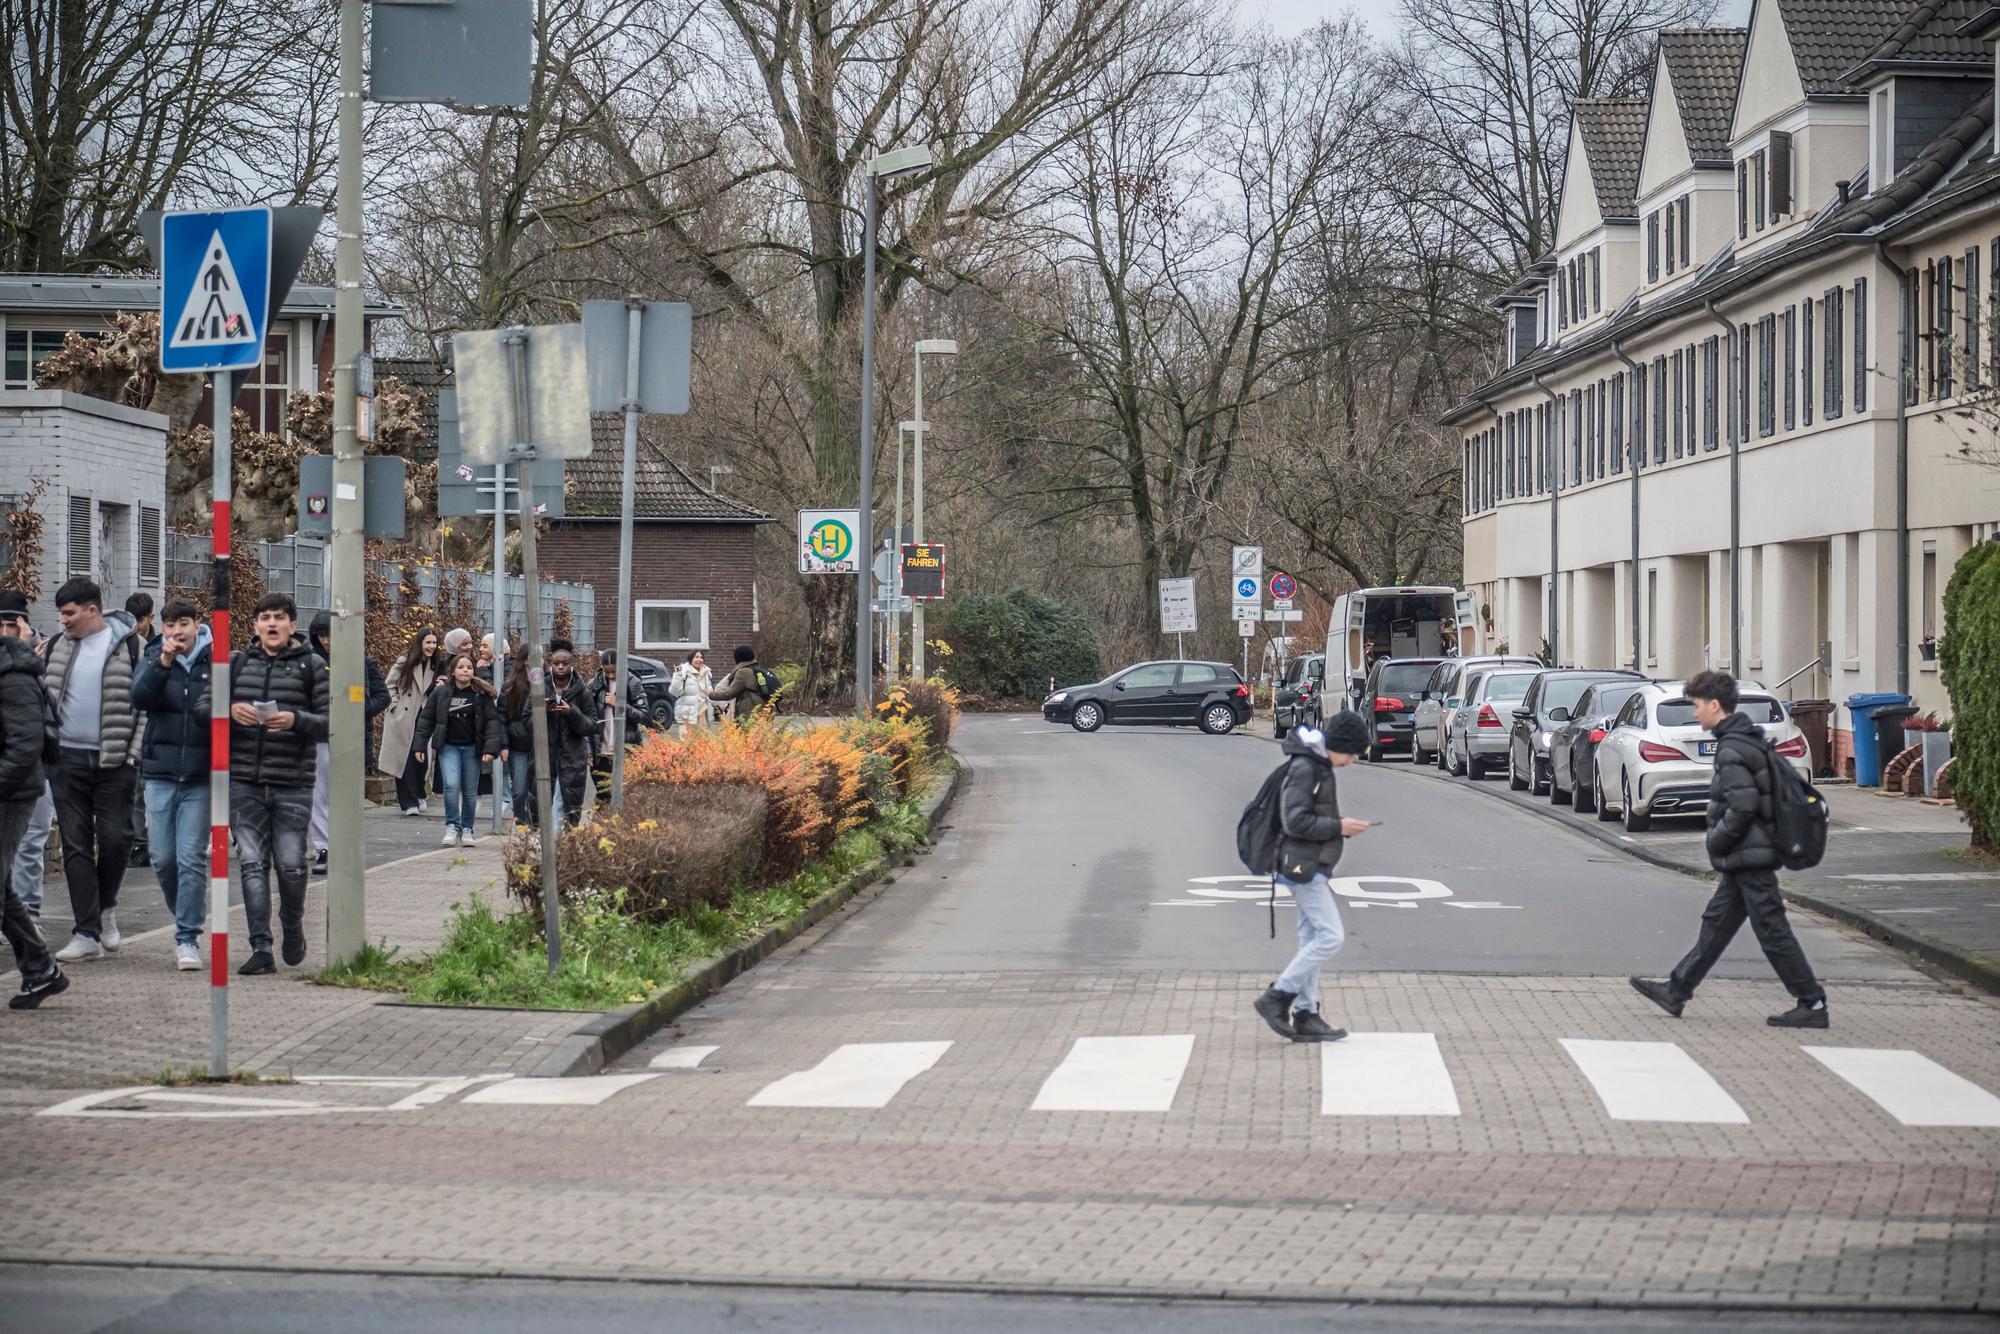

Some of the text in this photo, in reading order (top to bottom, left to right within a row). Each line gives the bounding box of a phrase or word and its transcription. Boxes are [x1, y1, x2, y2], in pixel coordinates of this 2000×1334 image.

[821, 529, 839, 554] H
[916, 548, 930, 558] SIE
[907, 558, 939, 567] FAHREN
[1247, 609, 1259, 617] frei
[1186, 875, 1454, 900] 30
